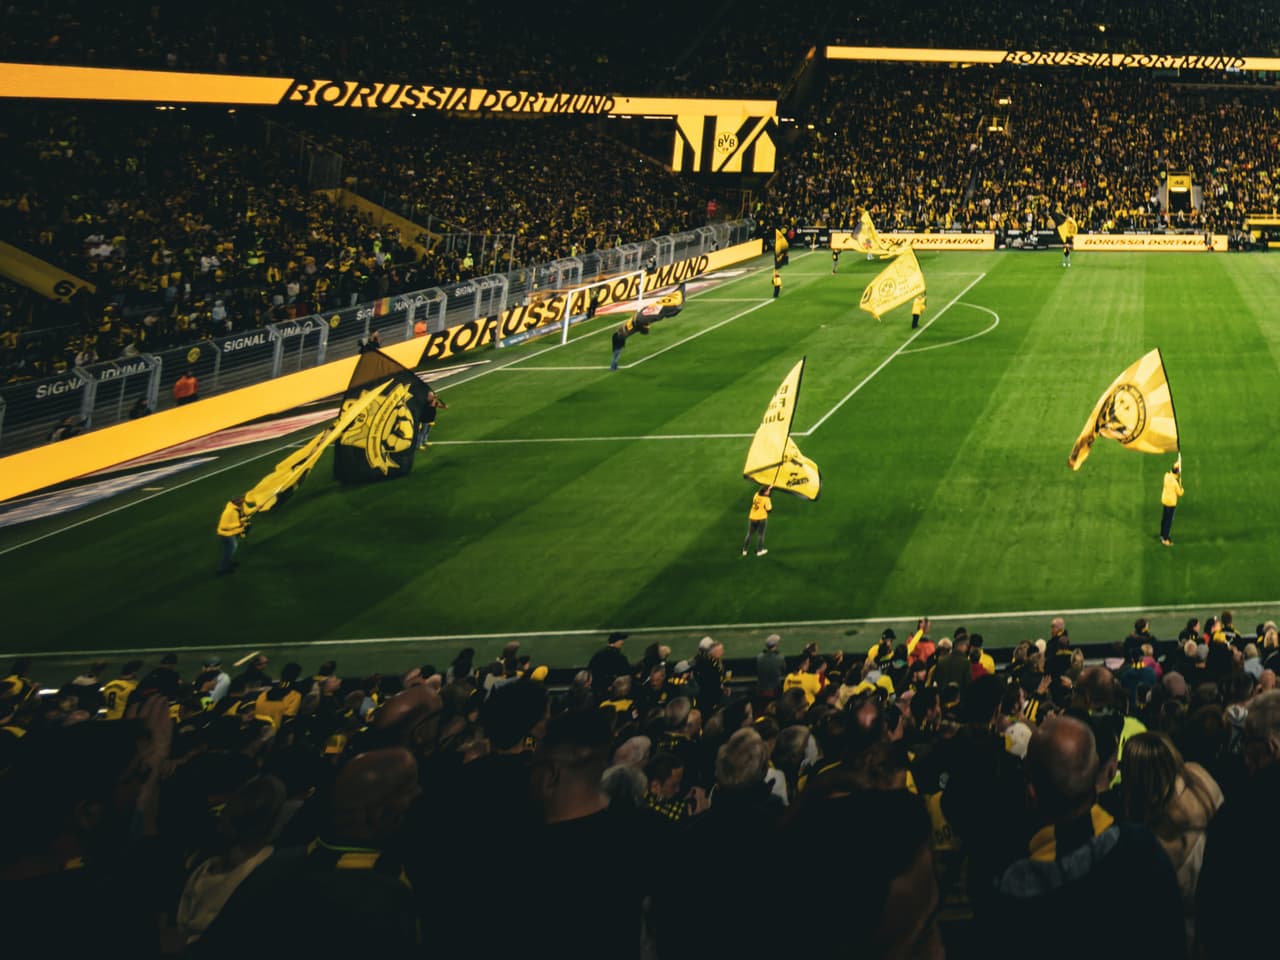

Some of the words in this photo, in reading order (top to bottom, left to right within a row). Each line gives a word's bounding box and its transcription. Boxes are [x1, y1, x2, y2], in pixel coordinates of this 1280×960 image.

[1001, 51, 1113, 66] BORUSSIA
[1120, 54, 1246, 70] DORTMUND
[280, 79, 472, 110] BORUSSIA
[476, 90, 615, 114] DORTMUND
[420, 289, 588, 360] BORUSSIA
[594, 255, 710, 305] DORTMUND
[223, 333, 266, 352] SIGNAL
[35, 376, 89, 399] SIGNA
